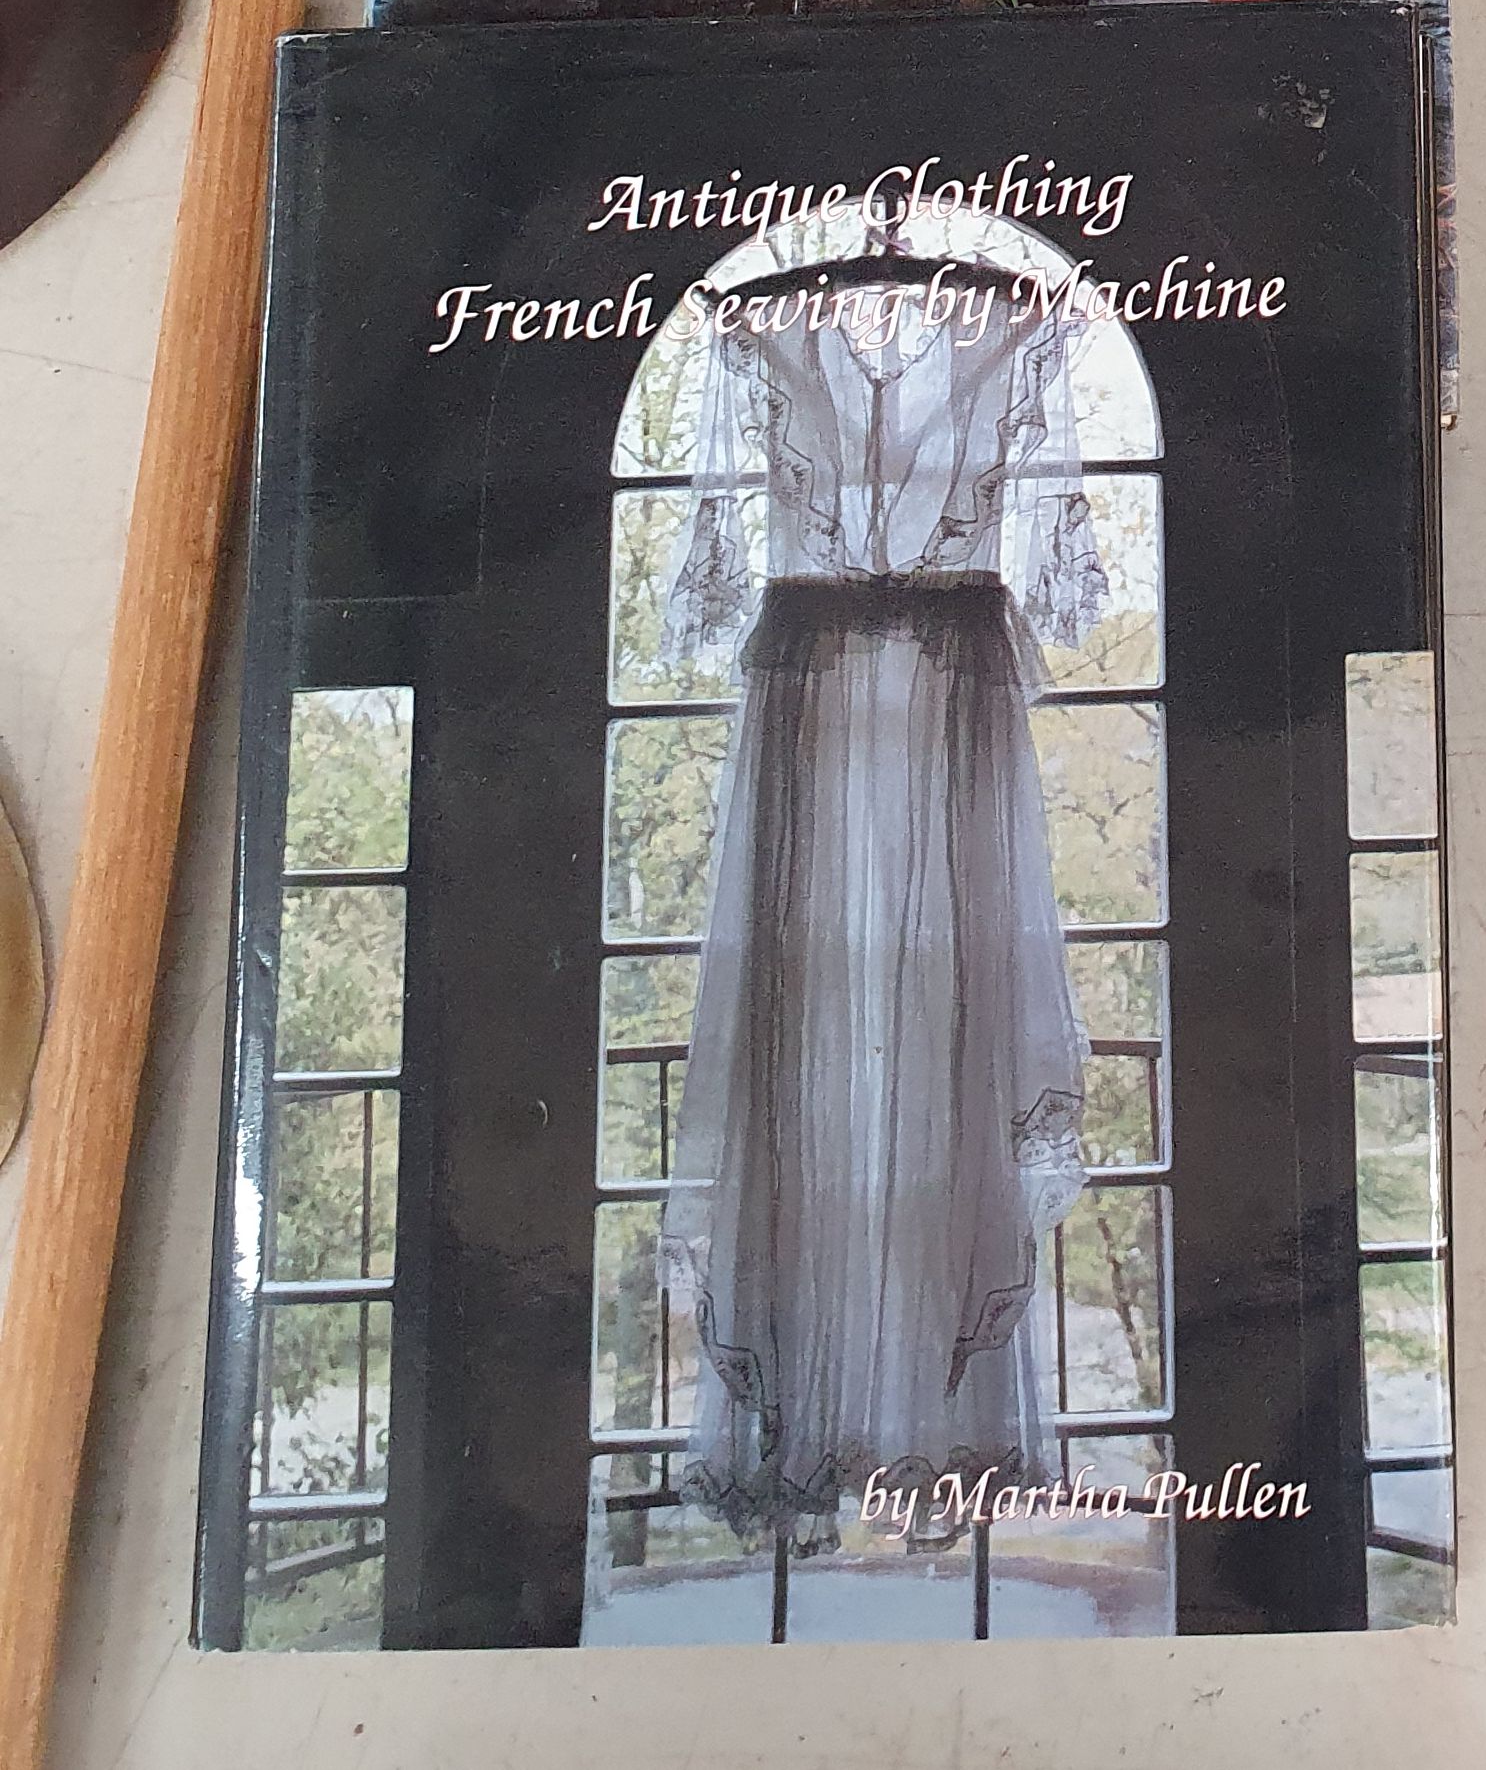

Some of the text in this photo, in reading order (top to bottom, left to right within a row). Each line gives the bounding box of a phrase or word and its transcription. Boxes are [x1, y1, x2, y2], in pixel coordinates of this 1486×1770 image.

[587, 154, 1133, 244] Antique Clothing
[429, 256, 1288, 353] French Sewing by Machine
[860, 1461, 1312, 1540] by Martha Pullen
